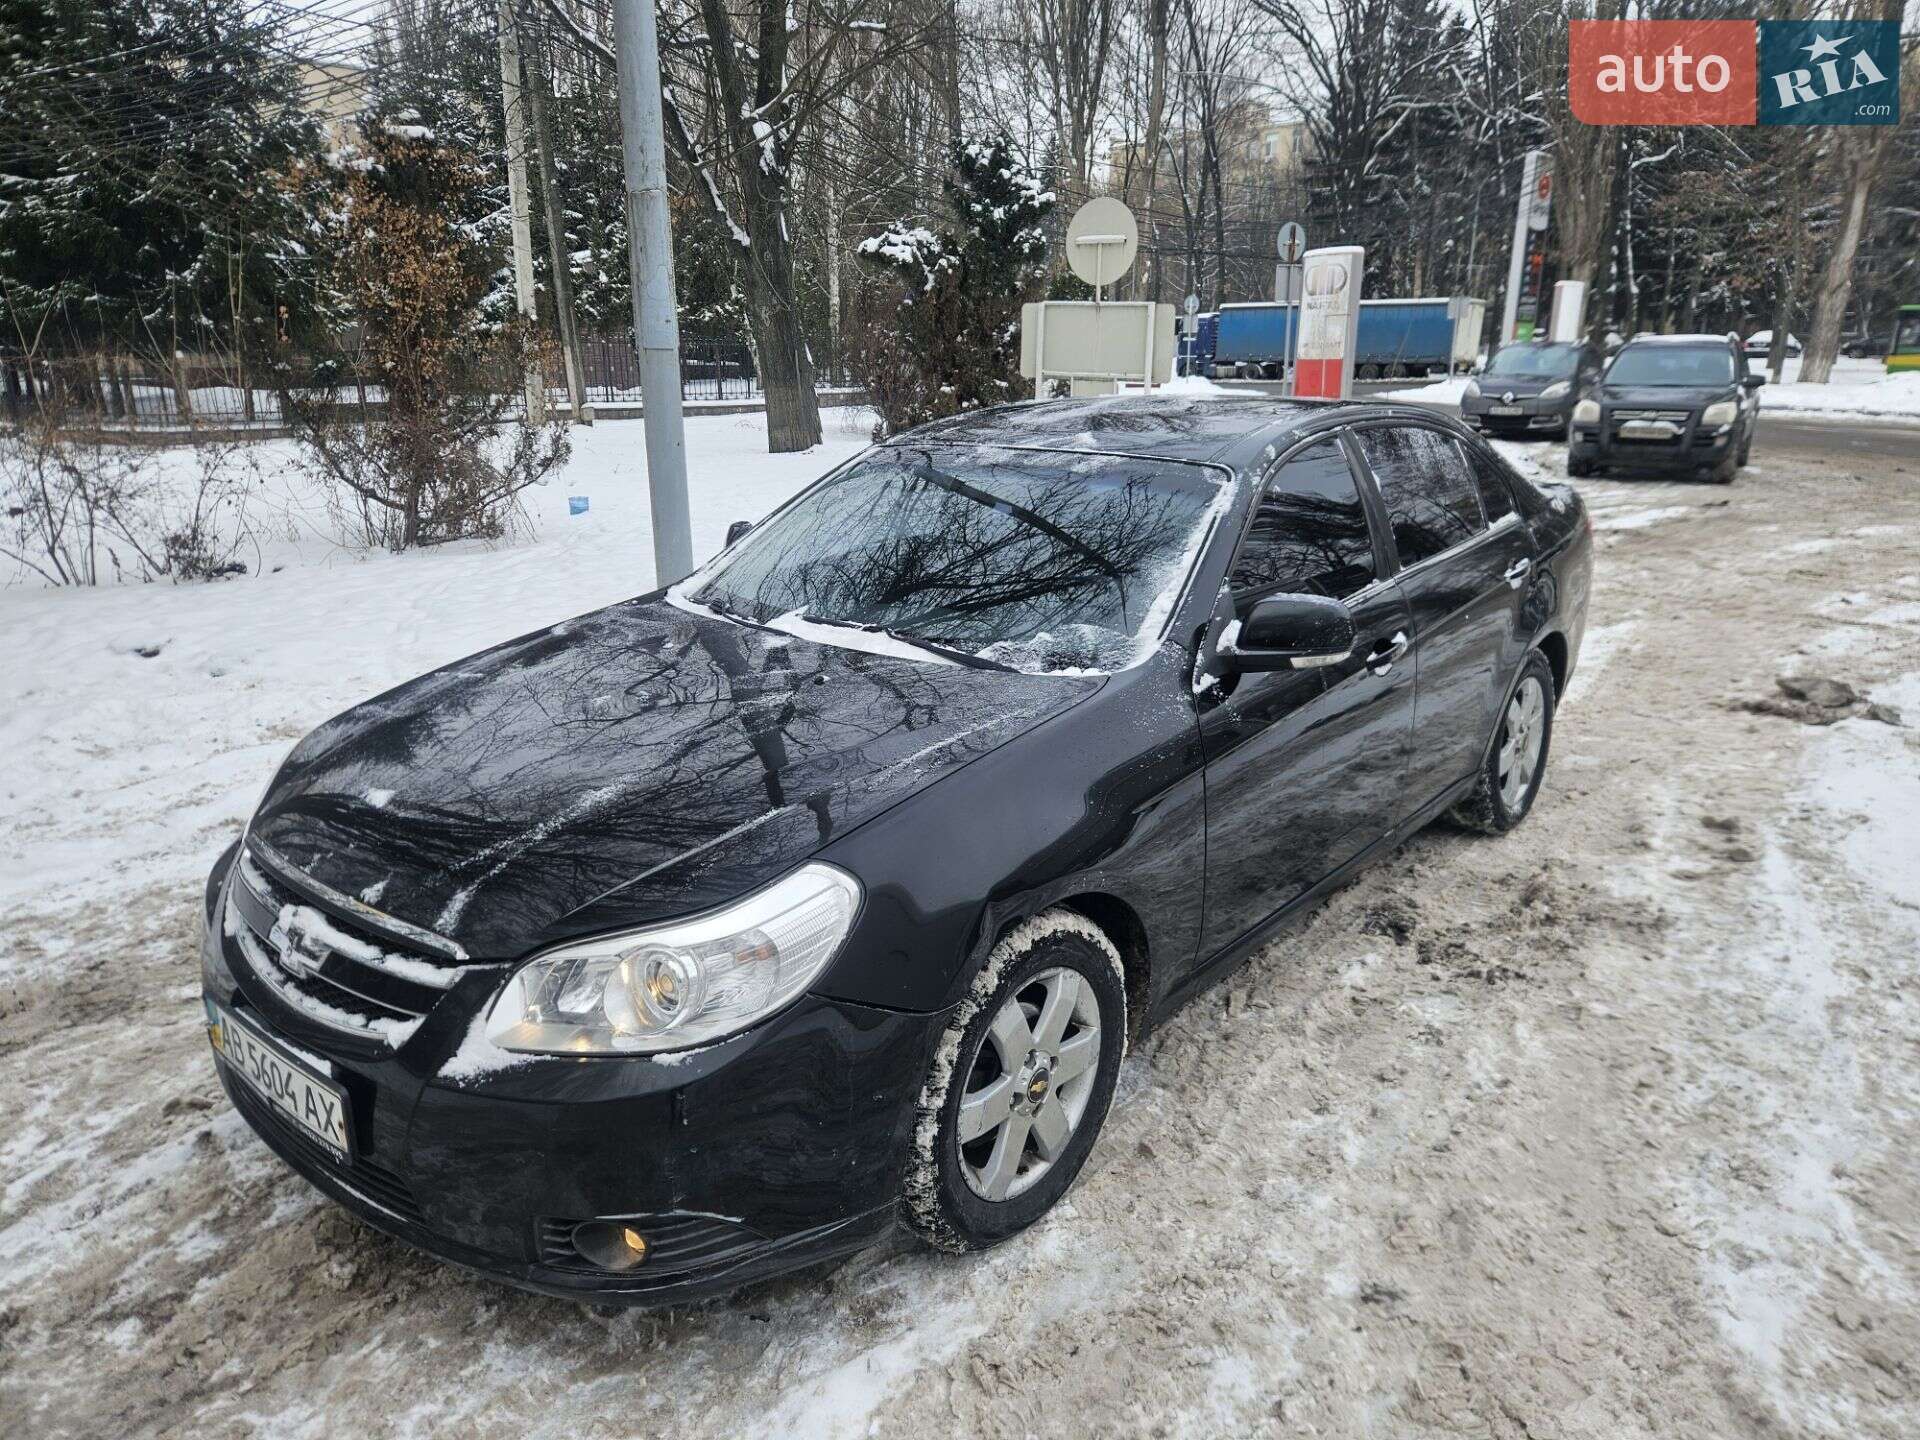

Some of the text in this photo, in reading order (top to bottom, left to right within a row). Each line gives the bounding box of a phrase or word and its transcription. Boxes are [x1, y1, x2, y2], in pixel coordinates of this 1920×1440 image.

[221, 1016, 340, 1142] AB 5604 AX
